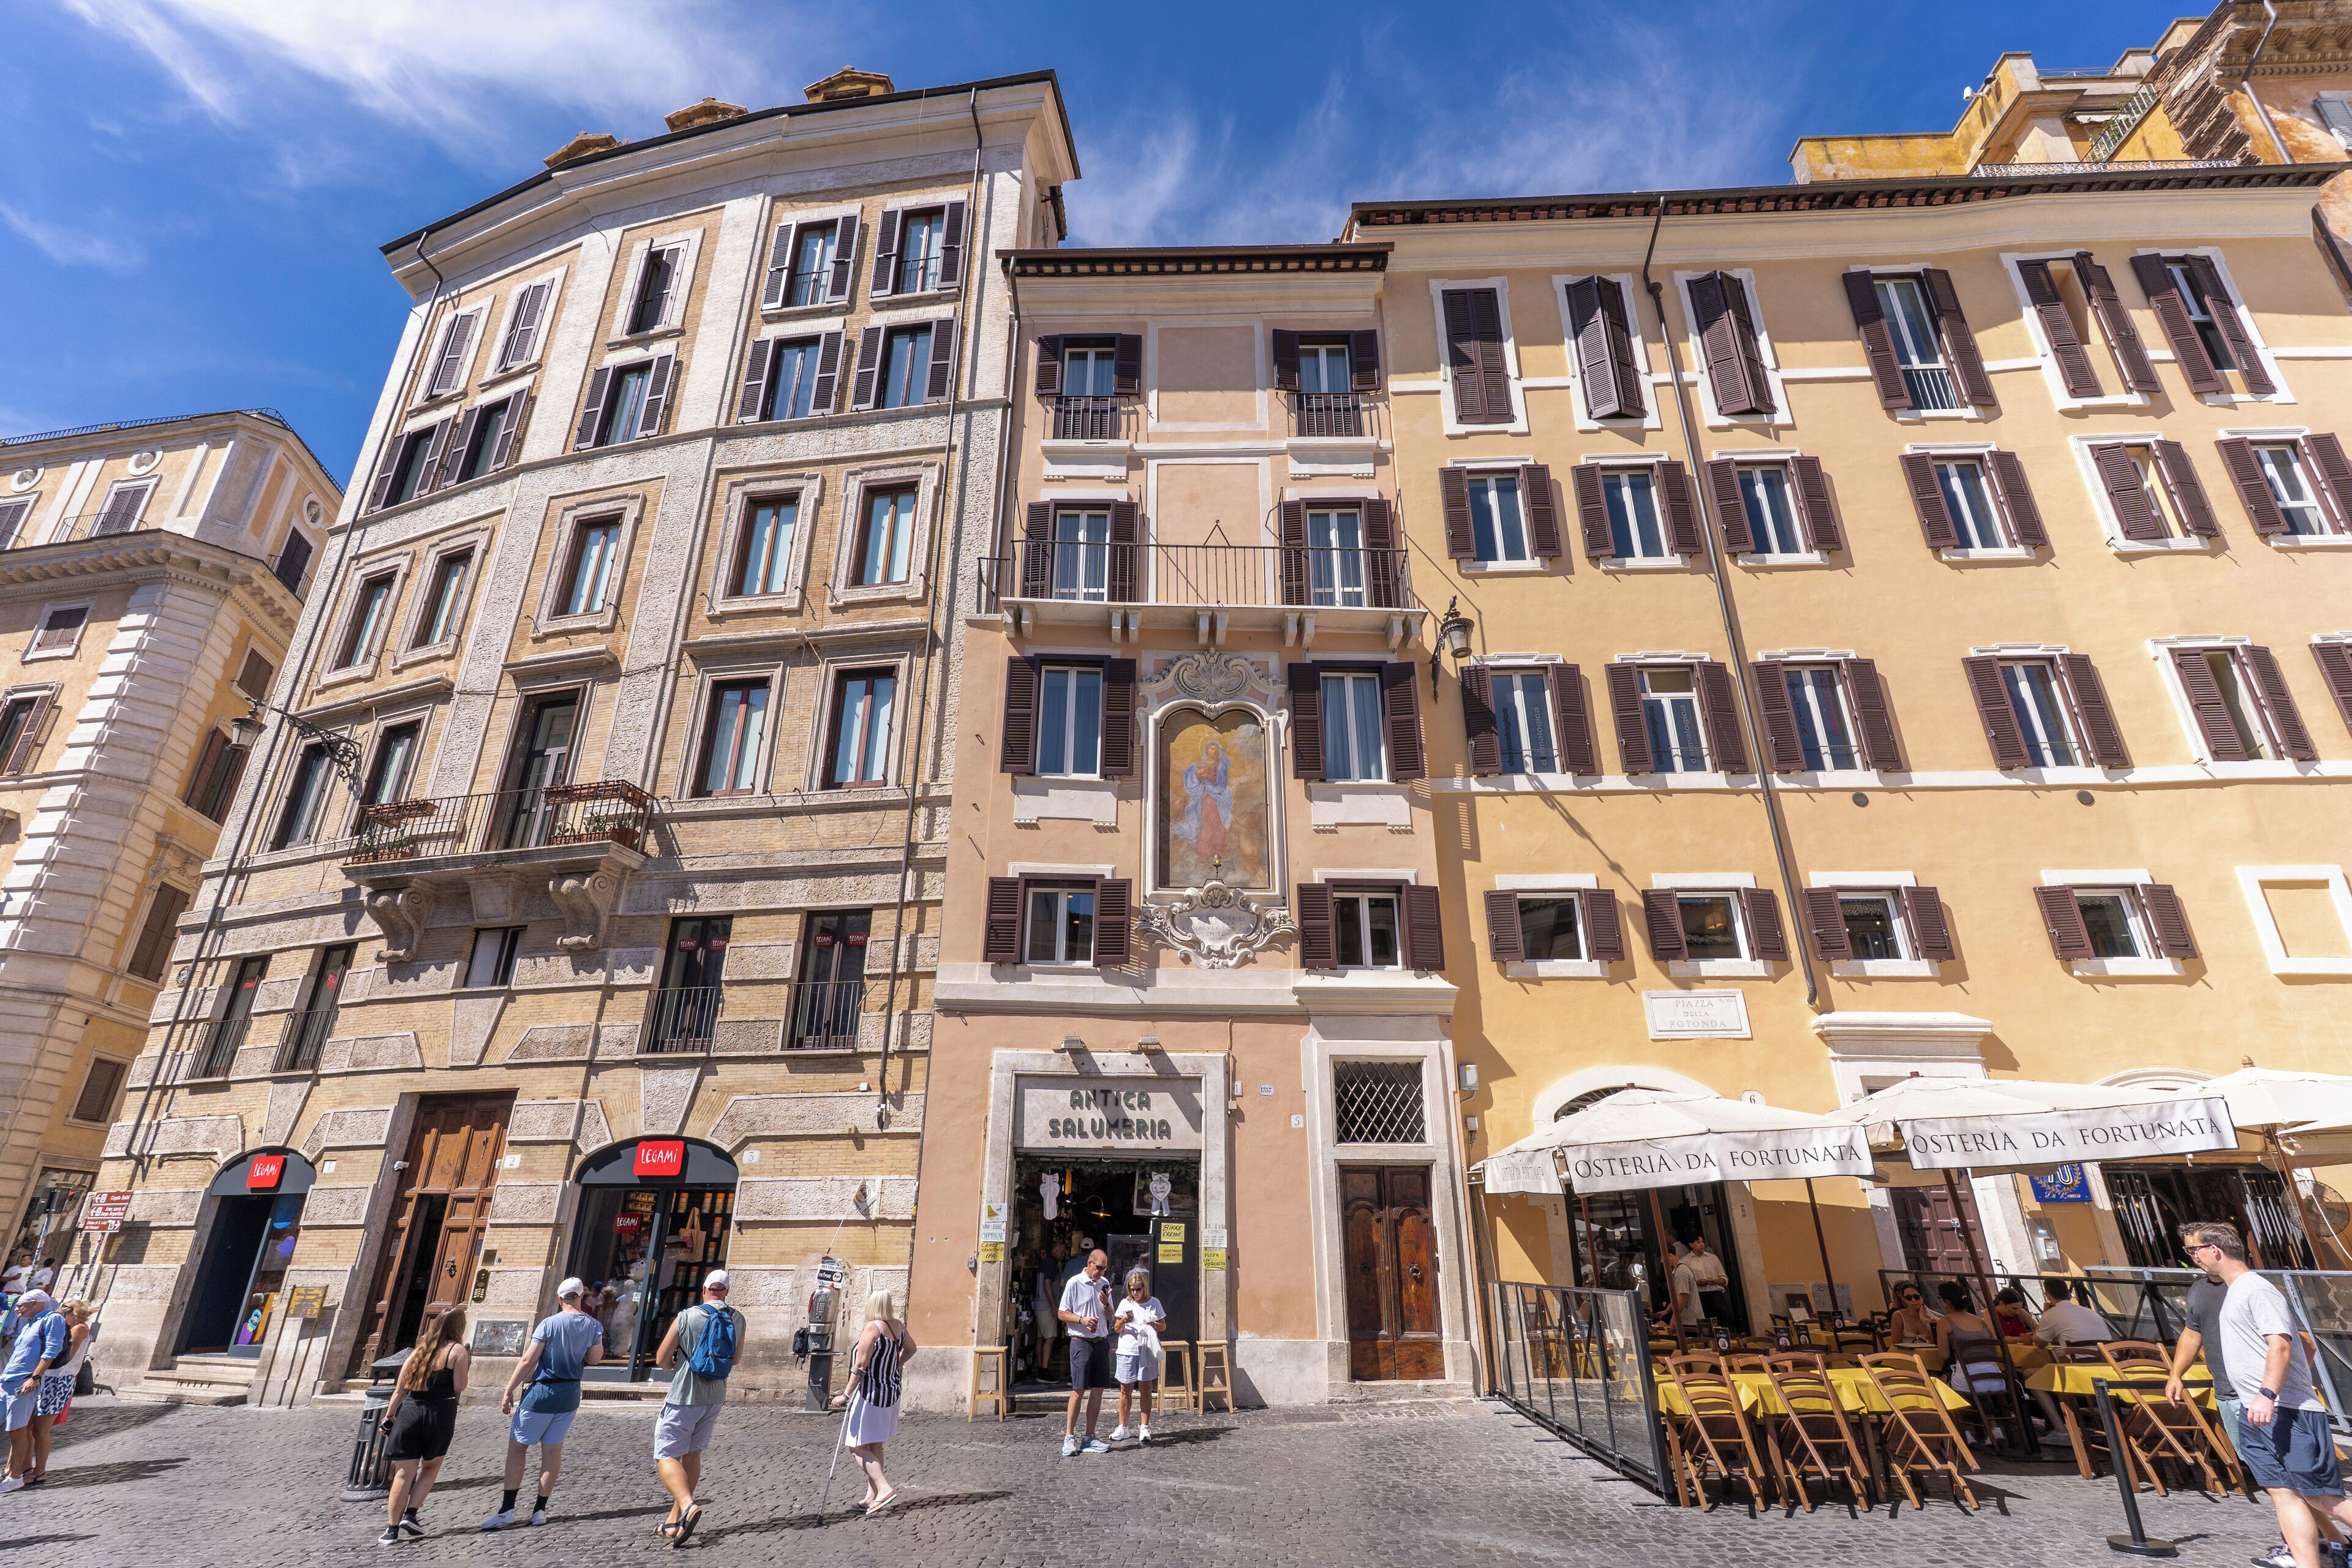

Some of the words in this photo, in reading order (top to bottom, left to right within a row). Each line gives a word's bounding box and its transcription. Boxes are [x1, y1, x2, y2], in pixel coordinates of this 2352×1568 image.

[1669, 1020, 1727, 1028] ROTONDA
[1070, 1089, 1149, 1109] ANTICA
[1749, 1095, 1756, 1104] 6
[1294, 1116, 1300, 1126] 5
[1049, 1117, 1169, 1138] SALUMERIA
[1912, 1131, 2019, 1154] OSTERIA
[2031, 1131, 2067, 1148] DA
[2078, 1117, 2222, 1145] FORTUNATA
[509, 1156, 515, 1166] 2
[748, 1152, 754, 1161] 3
[1575, 1153, 1673, 1178] OSTERIA
[1684, 1152, 1718, 1170] DA
[1728, 1145, 1863, 1167] FORTUNATA
